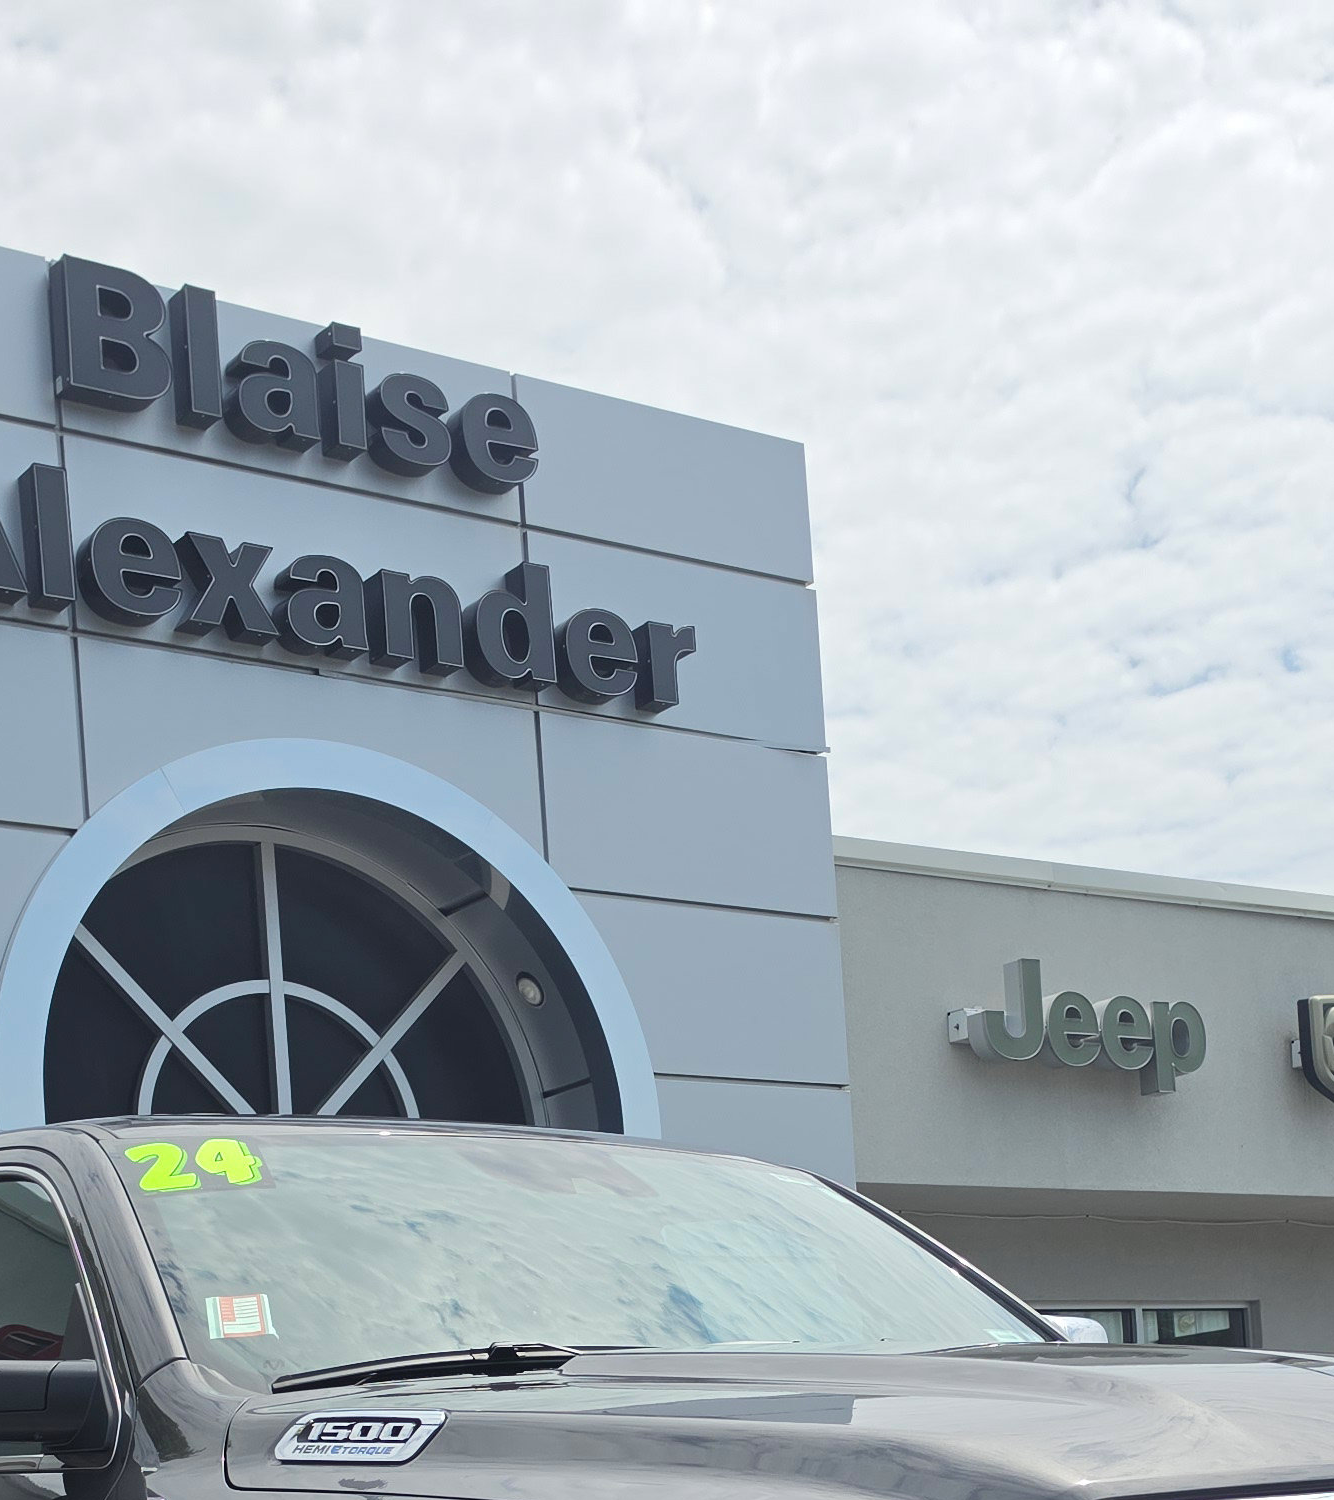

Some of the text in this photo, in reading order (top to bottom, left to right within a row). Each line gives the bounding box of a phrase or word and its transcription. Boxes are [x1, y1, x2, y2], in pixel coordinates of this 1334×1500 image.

[50, 253, 539, 495] Blaise
[967, 958, 1207, 1096] Jeep
[124, 1138, 263, 1193] 24
[292, 1444, 332, 1455] HEMI
[307, 1421, 416, 1441] 1500
